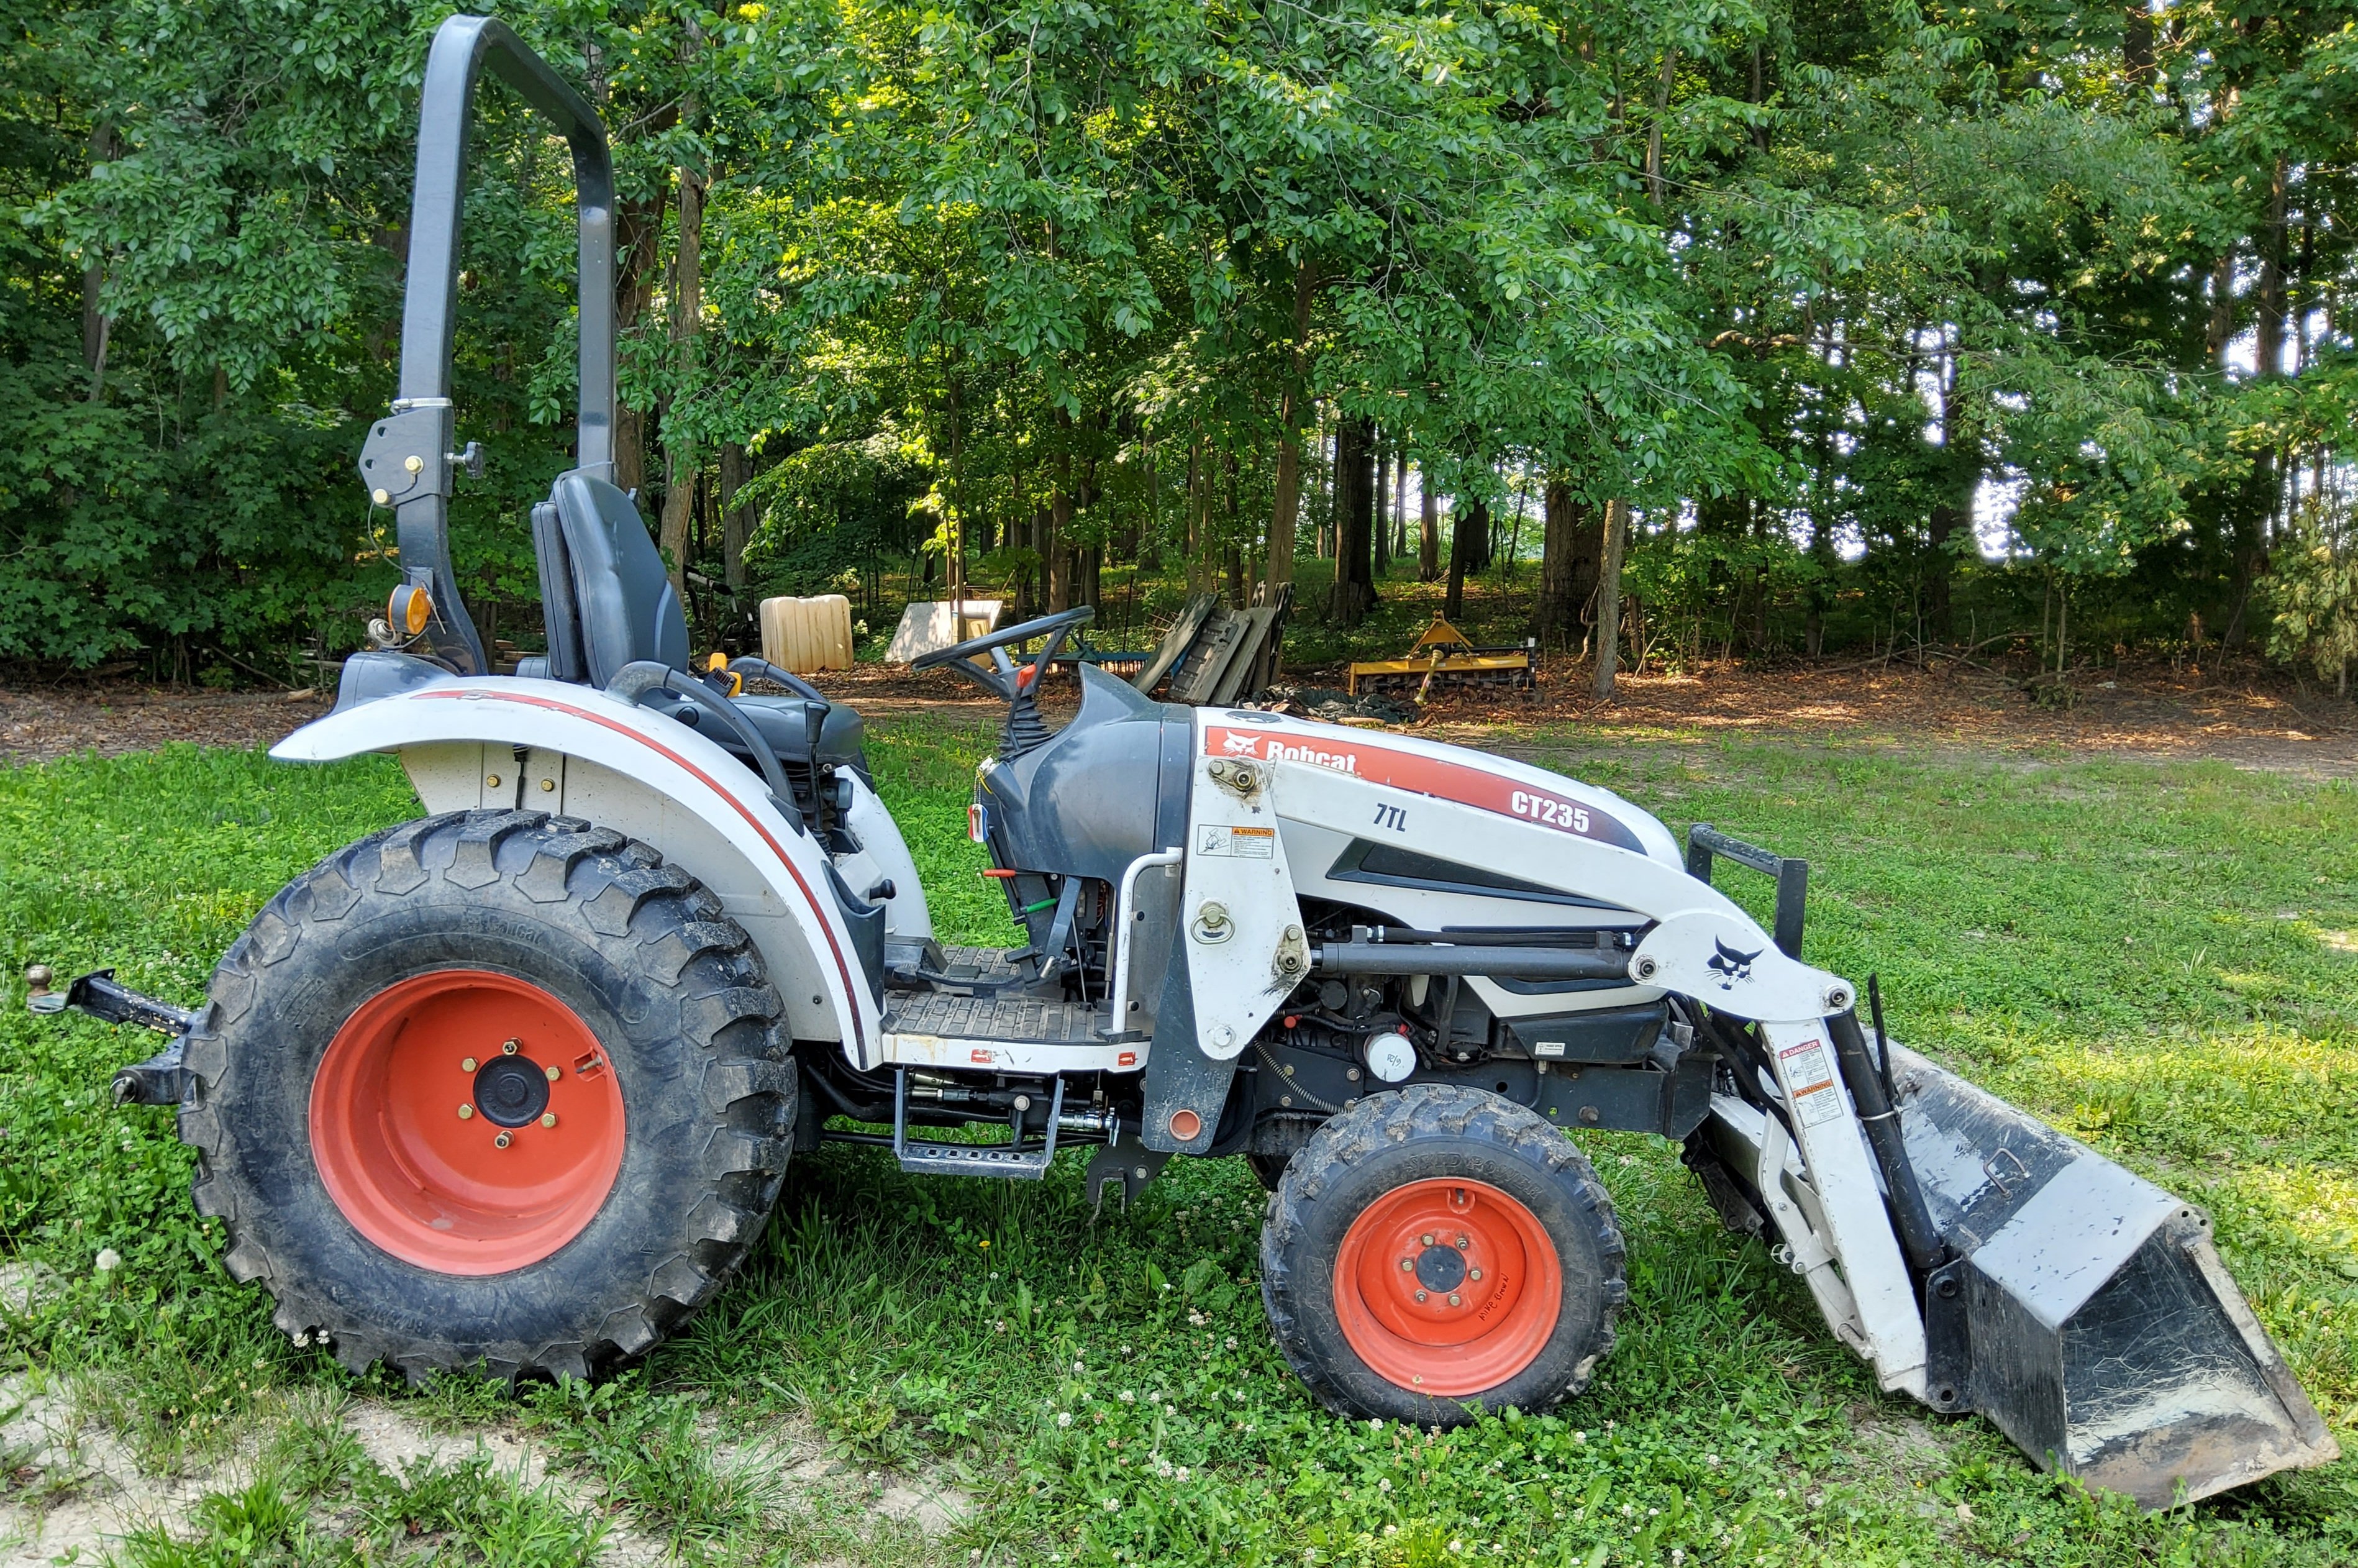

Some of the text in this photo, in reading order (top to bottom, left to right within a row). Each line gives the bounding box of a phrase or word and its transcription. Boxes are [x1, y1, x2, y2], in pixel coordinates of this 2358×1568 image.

[1266, 740, 1357, 775] Bobcat
[1373, 802, 1407, 832] 7TL
[1511, 790, 1590, 833] CT235
[1789, 1041, 1818, 1055] DANGER
[1801, 1081, 1831, 1095] WARNING
[1466, 1155, 1544, 1200] POWER
